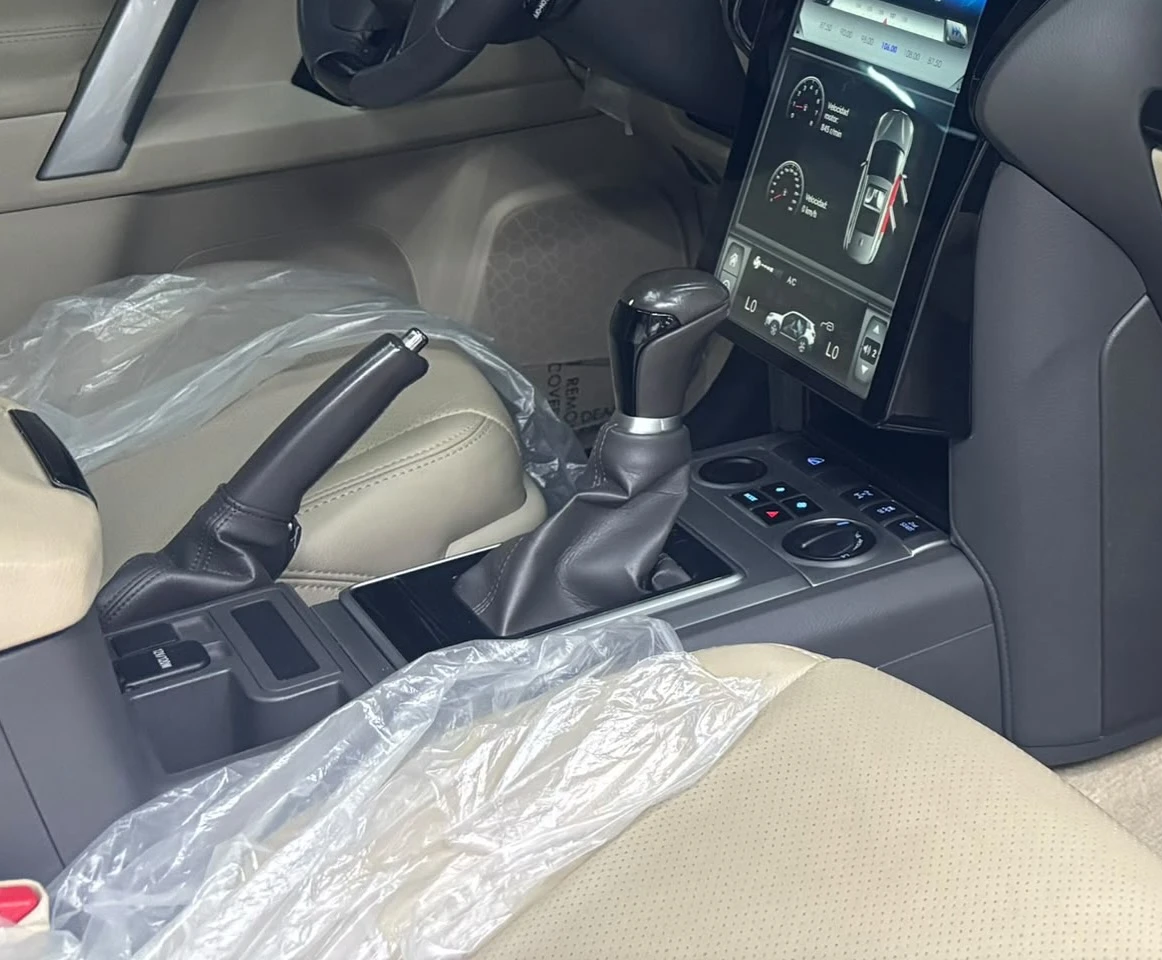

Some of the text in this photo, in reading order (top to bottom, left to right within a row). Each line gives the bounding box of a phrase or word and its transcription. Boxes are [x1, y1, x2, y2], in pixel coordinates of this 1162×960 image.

[786, 276, 797, 287] AC
[744, 295, 758, 313] LO
[825, 341, 840, 360] LO
[870, 349, 877, 359] 2
[564, 377, 580, 426] REMO
